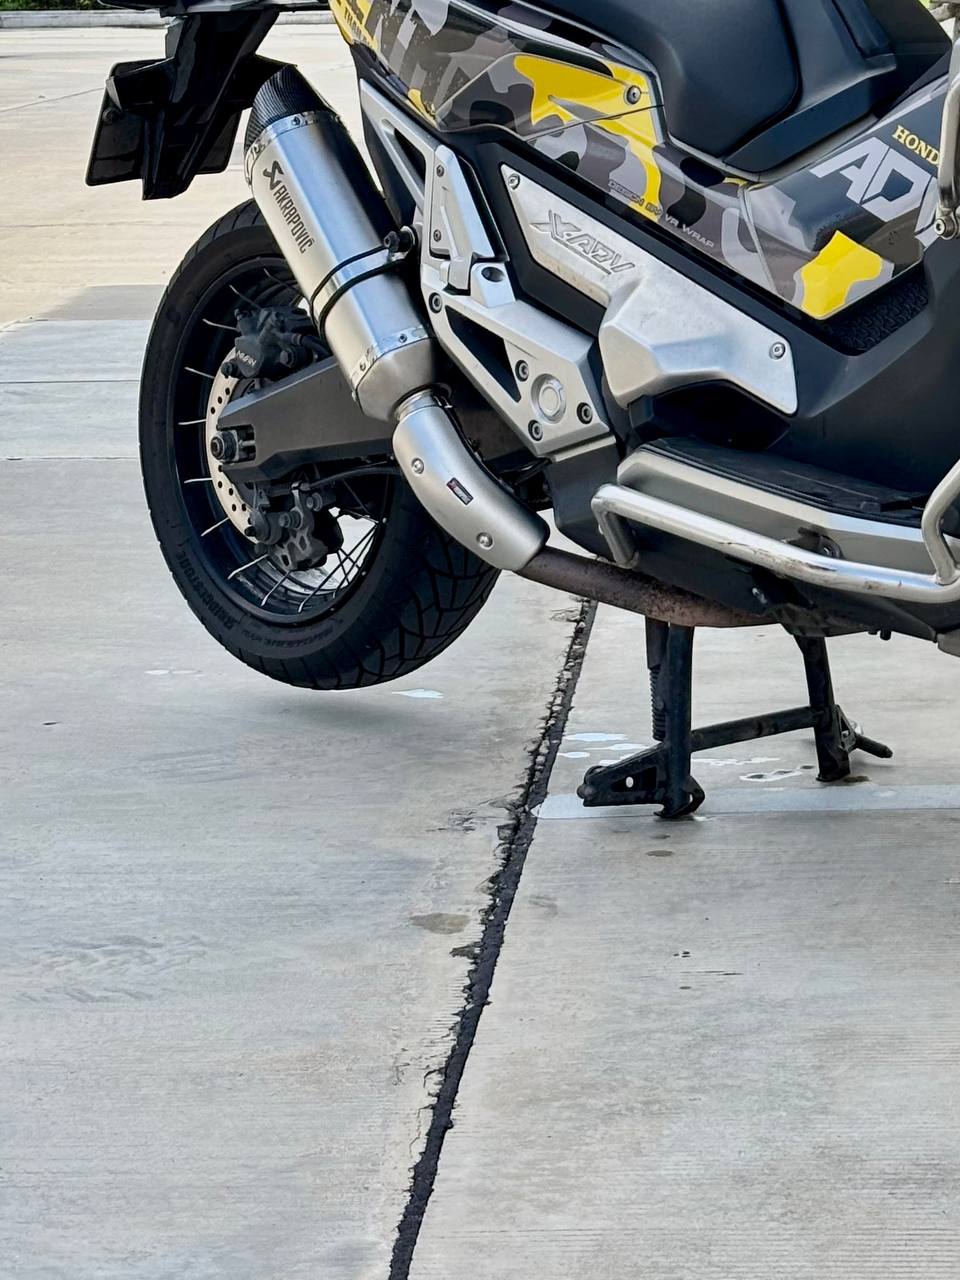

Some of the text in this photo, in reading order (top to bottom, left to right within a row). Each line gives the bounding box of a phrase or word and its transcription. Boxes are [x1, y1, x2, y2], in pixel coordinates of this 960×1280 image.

[892, 124, 940, 166] HOND
[665, 213, 680, 227] VR
[682, 223, 715, 248] WRAP
